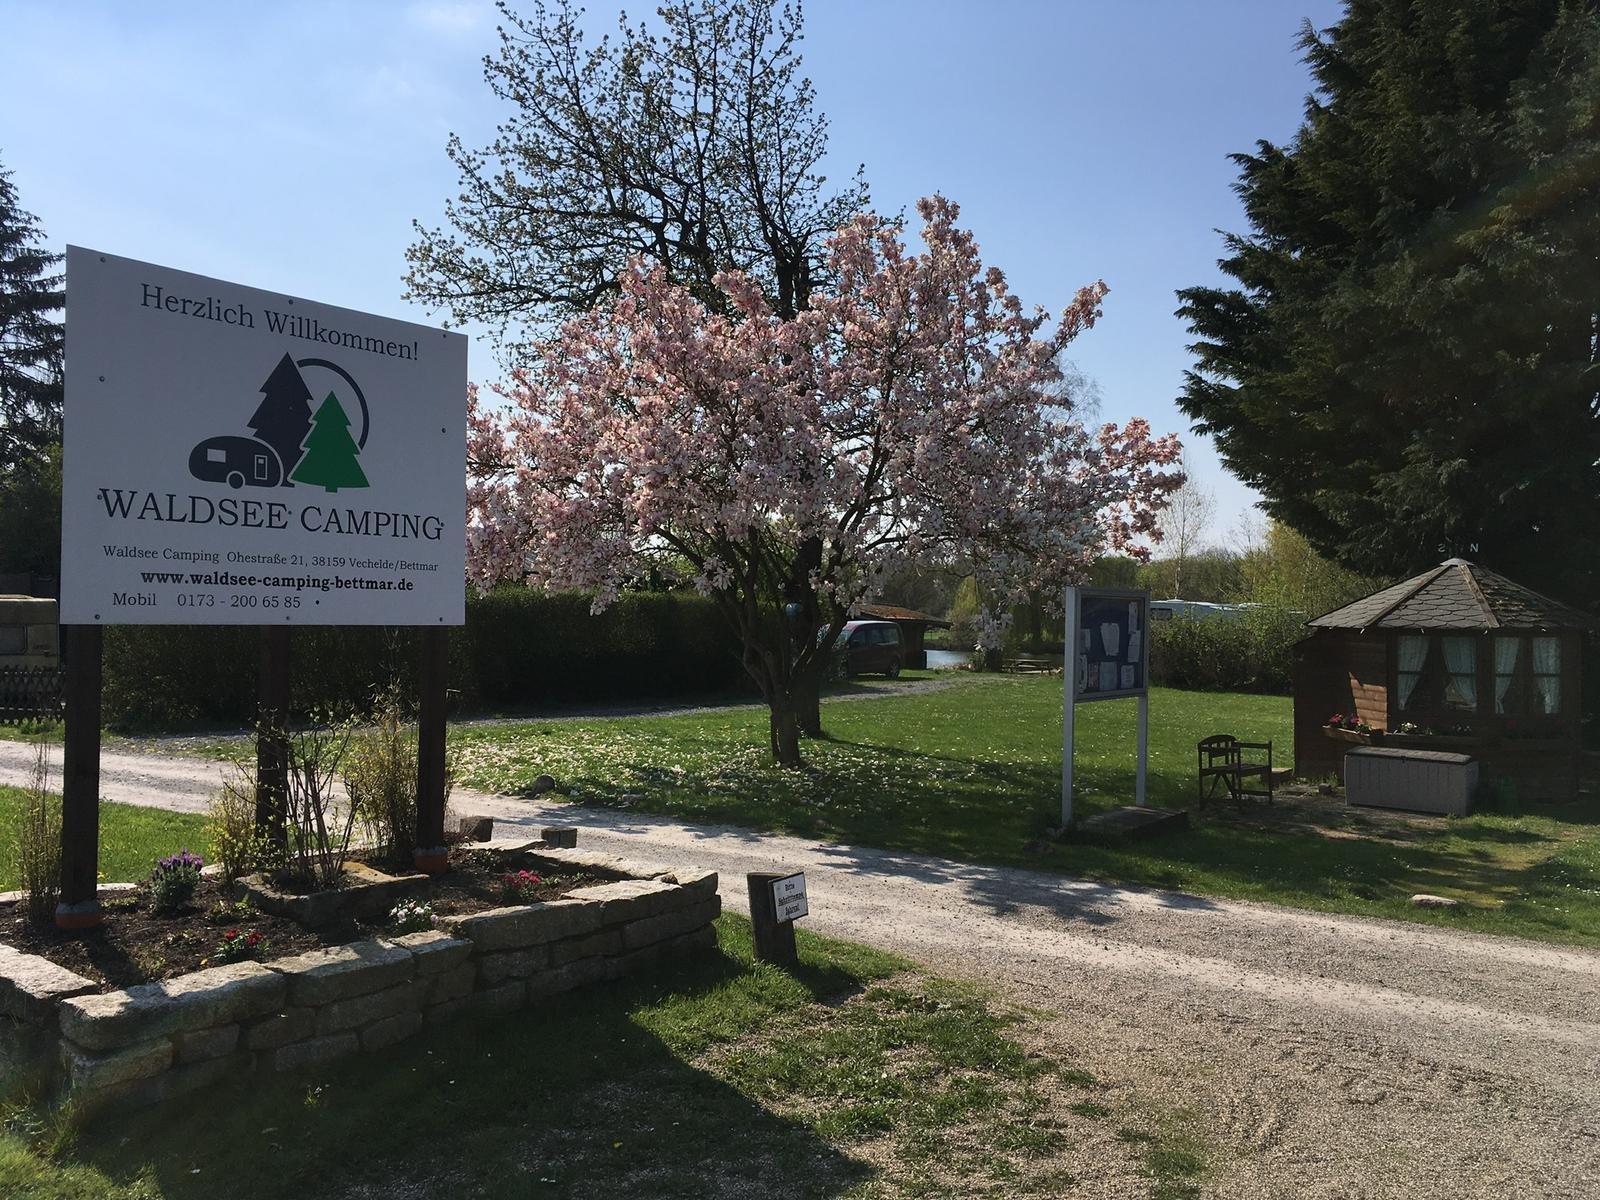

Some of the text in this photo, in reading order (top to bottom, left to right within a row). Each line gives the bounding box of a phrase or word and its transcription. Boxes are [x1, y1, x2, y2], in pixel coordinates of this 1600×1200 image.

[141, 283, 419, 361] Herzlich Willkommen!
[99, 487, 443, 541] WALDSEE CAMPING
[103, 545, 439, 573] Waldsee Camping Ohestraße 21, 38159 Vechelde/Bettmar
[140, 571, 414, 592] www.waldsee-camping-bettmar.de
[112, 592, 157, 606] Mobil
[176, 594, 215, 608] 0173
[229, 595, 258, 608] 200
[262, 595, 279, 608] 65
[283, 595, 301, 608] 85
